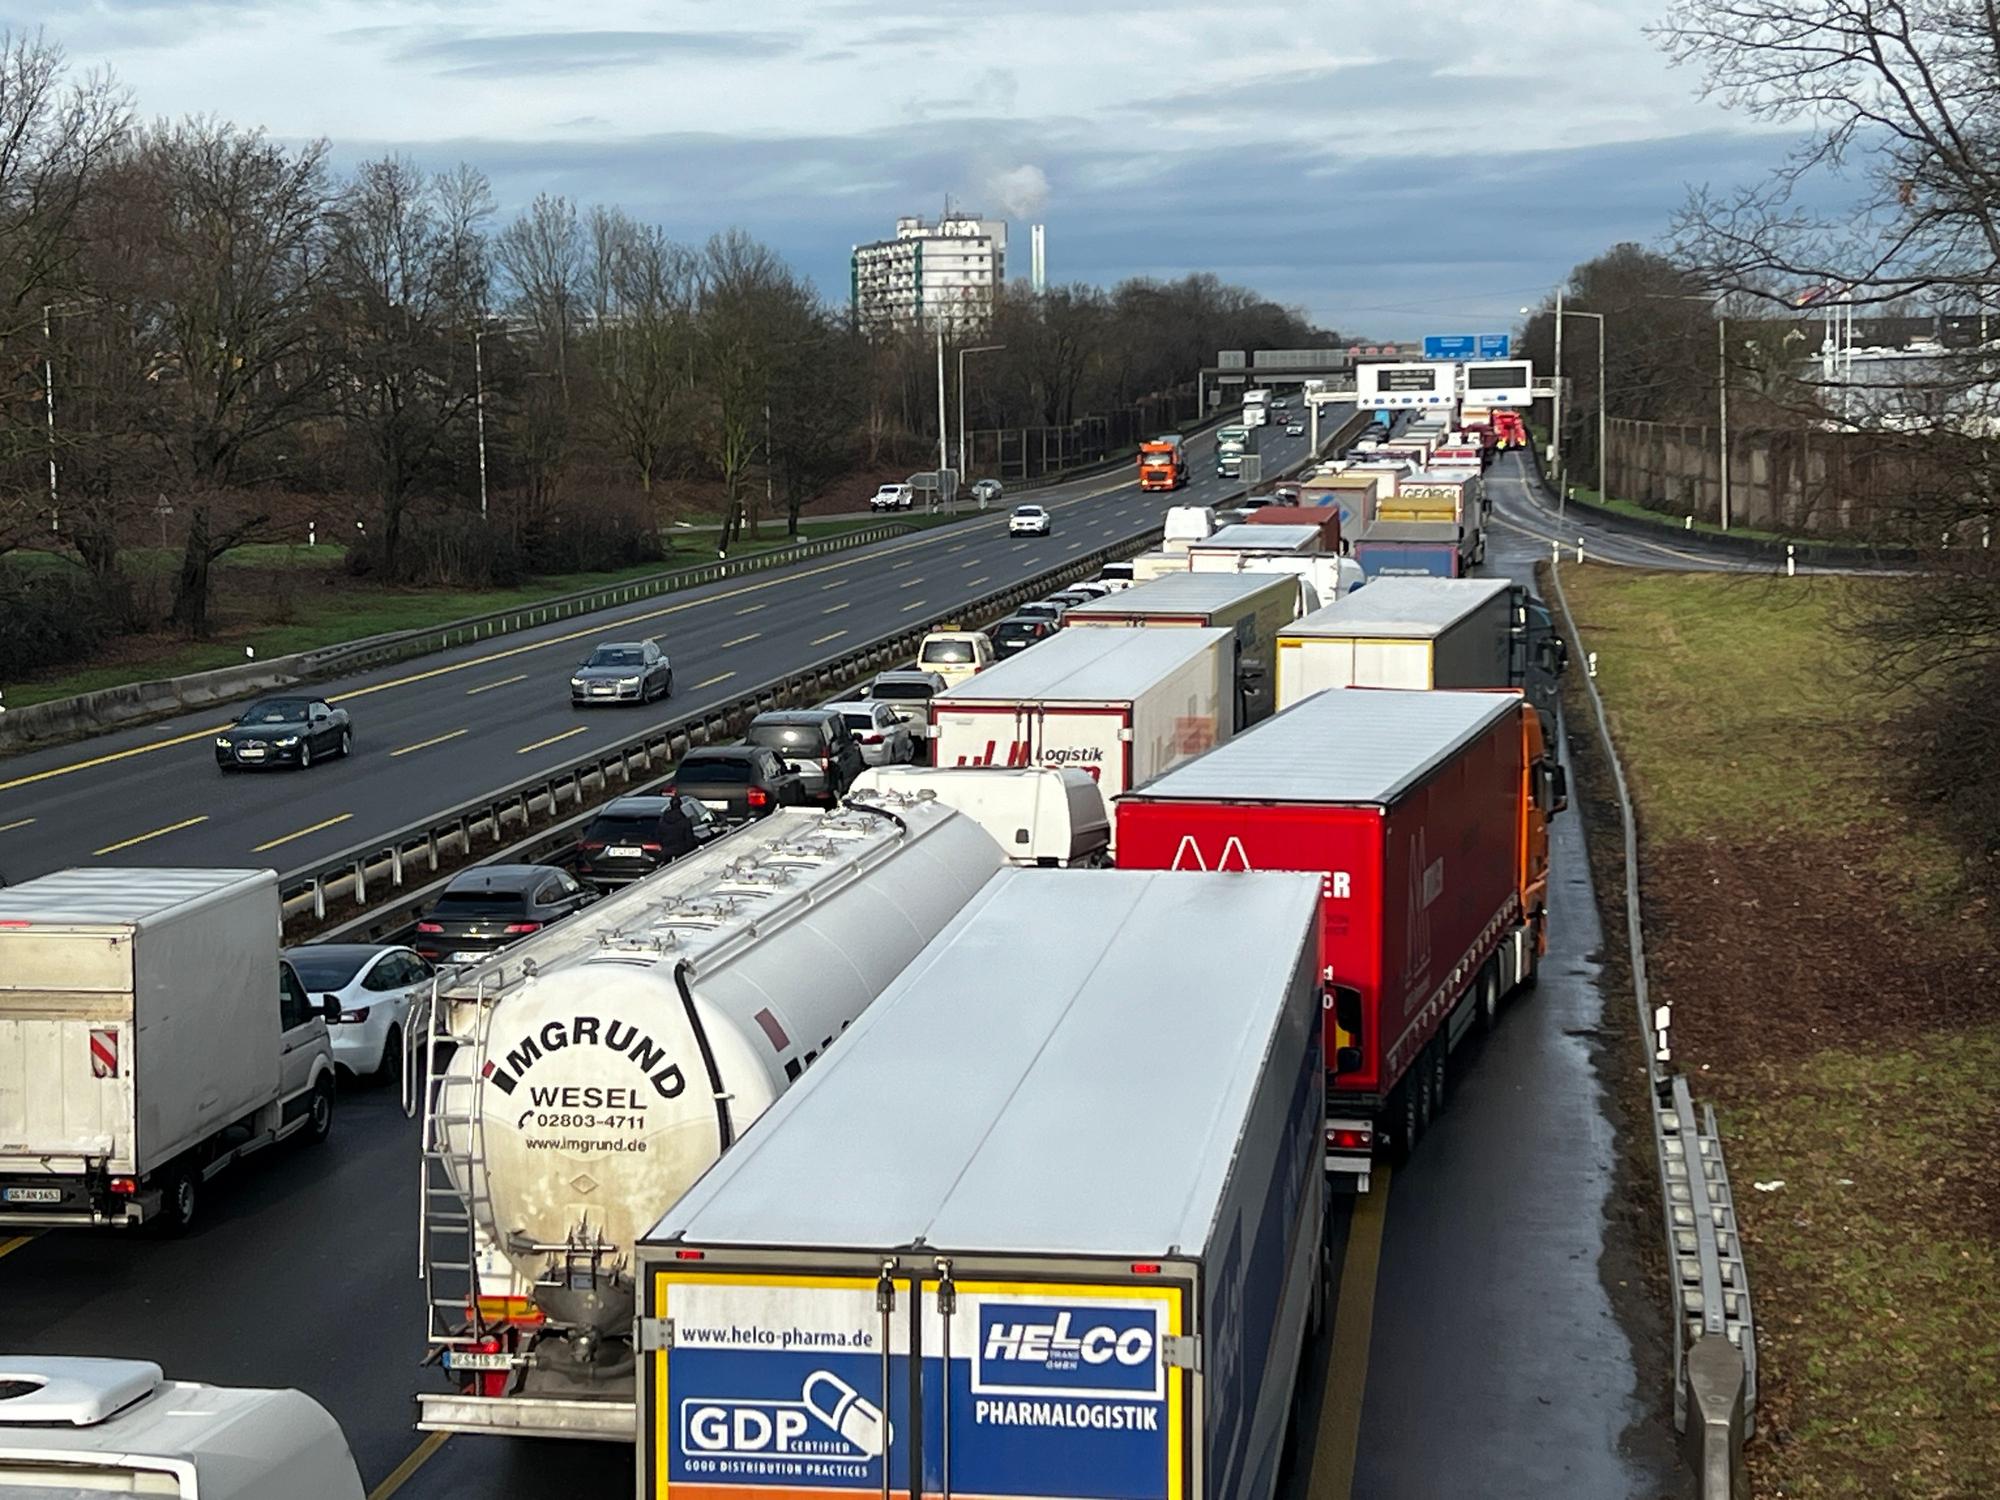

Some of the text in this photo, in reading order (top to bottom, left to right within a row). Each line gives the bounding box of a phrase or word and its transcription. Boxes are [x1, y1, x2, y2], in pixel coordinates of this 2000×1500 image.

[1035, 745, 1104, 765] Logistik
[530, 1086, 648, 1110] WESEL
[537, 1112, 645, 1130] 02803-4711
[526, 1136, 648, 1153] www.imgrund.de
[681, 1324, 874, 1350] www.helco-pharma.de
[984, 1311, 1154, 1366] HELCO
[975, 1400, 1159, 1431] PHARMALOGISTIK
[690, 1406, 808, 1452] GDP
[790, 1440, 850, 1454] CERTIFIED
[684, 1459, 869, 1477] GOOD DISTRIBUTION PRACTICES
